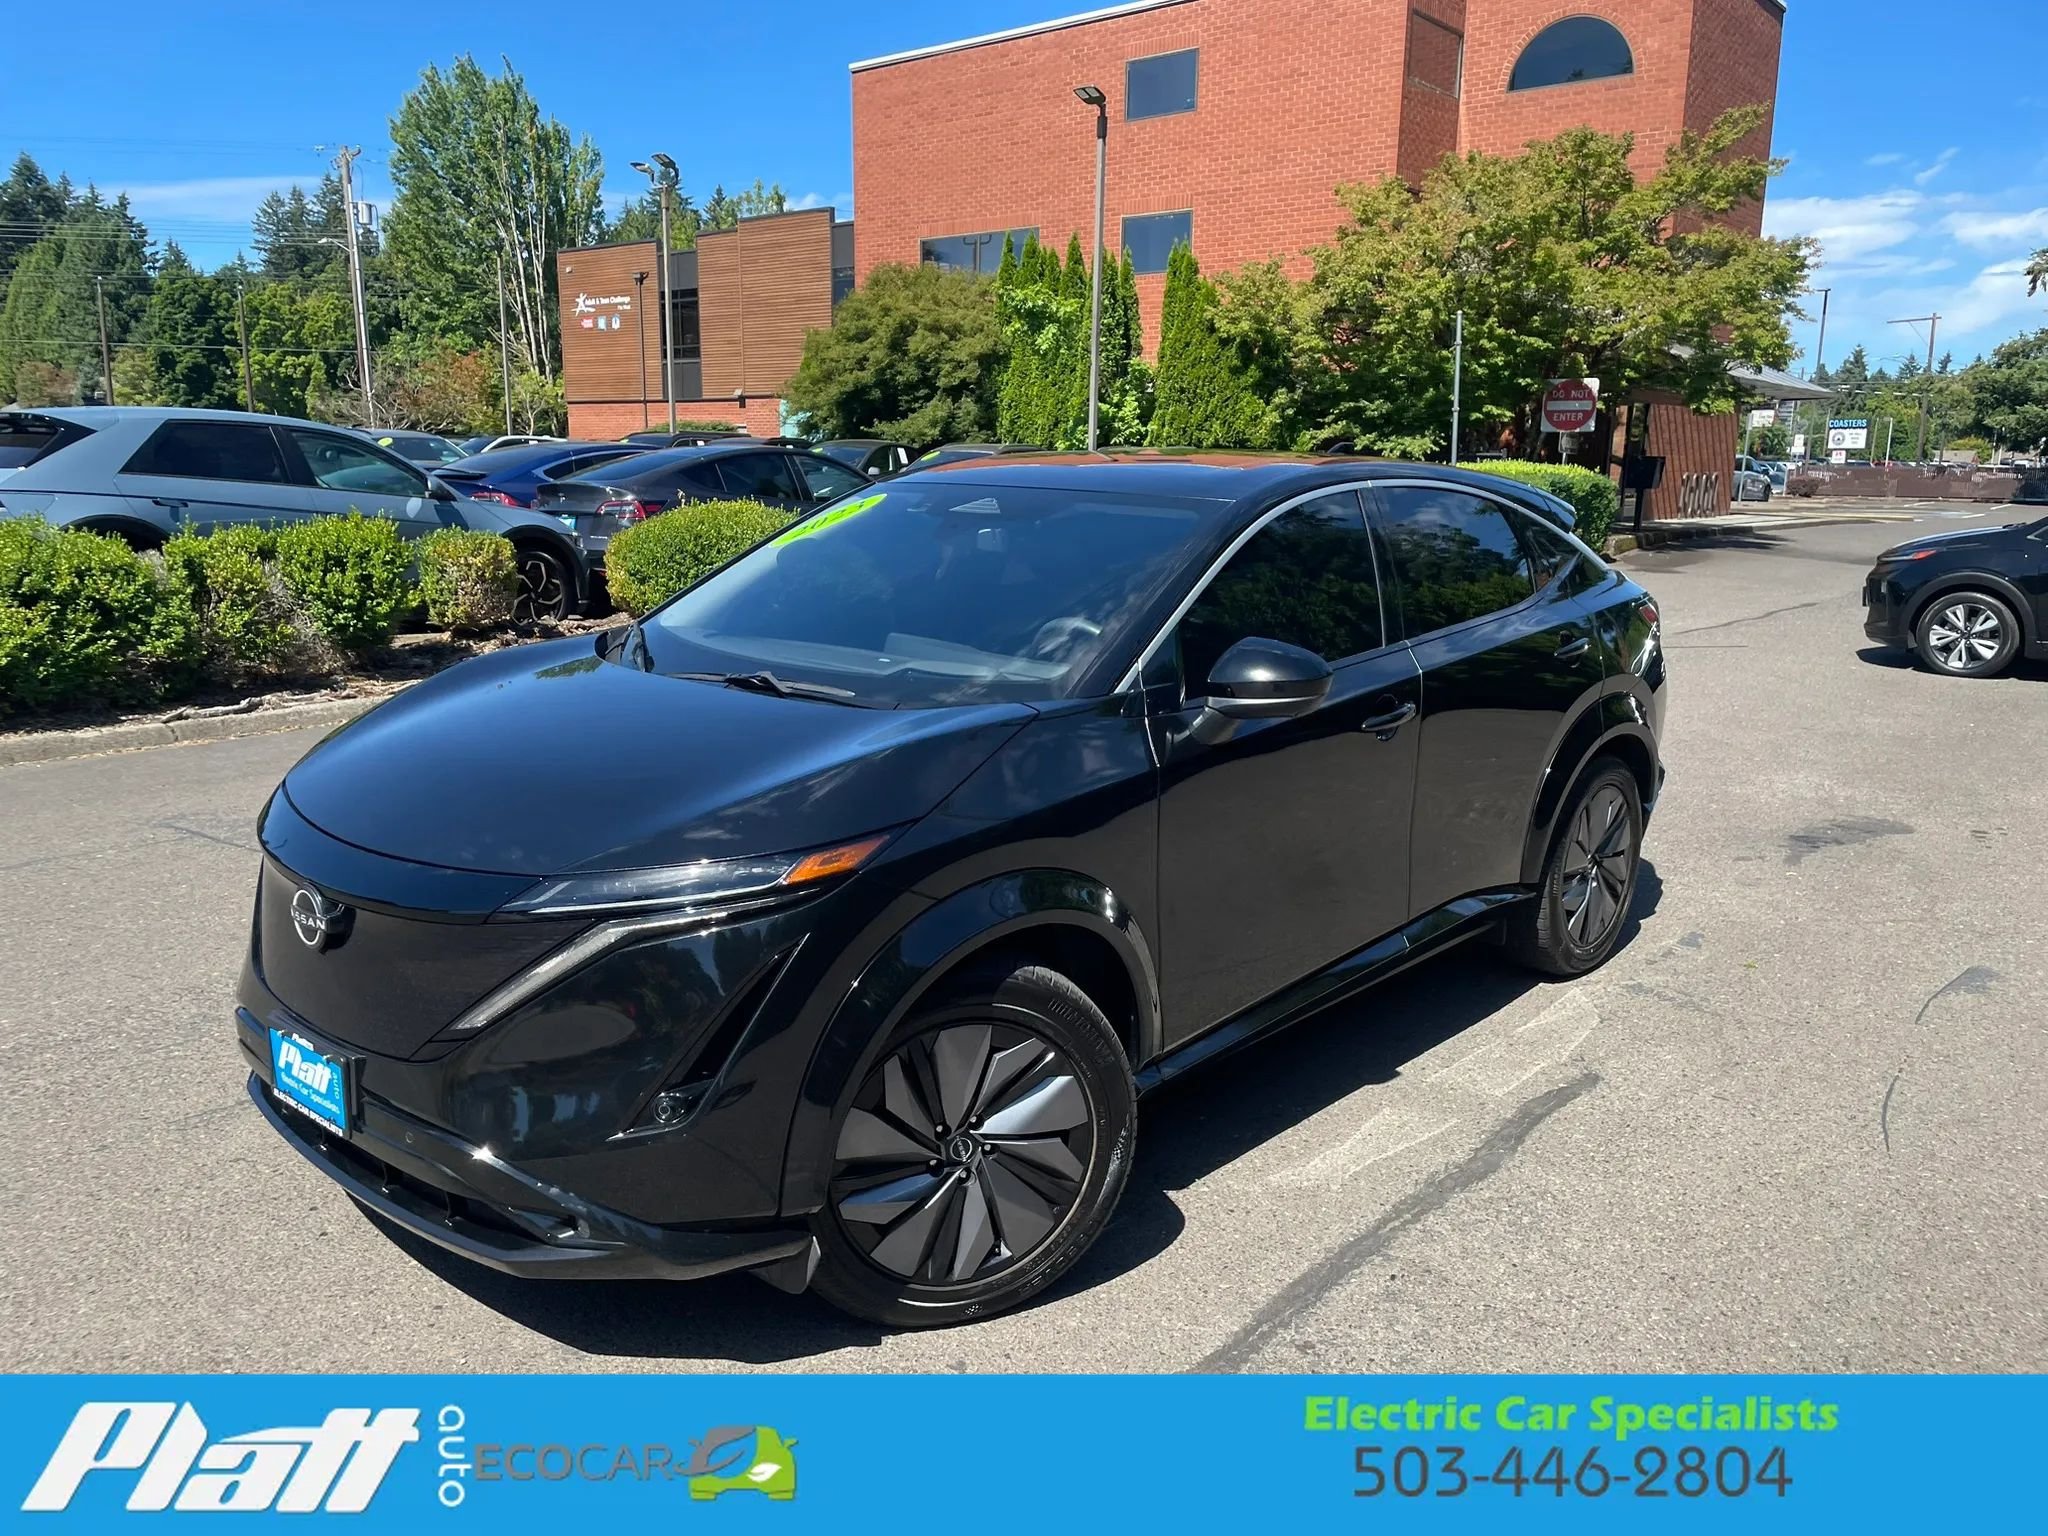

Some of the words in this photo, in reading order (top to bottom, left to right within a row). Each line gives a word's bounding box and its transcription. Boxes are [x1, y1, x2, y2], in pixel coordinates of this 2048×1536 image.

[1552, 390, 1565, 399] DO
[1571, 389, 1590, 398] NOT
[1553, 412, 1583, 421] ENTER
[1829, 419, 1868, 428] COASTERS
[278, 1041, 333, 1095] Platt
